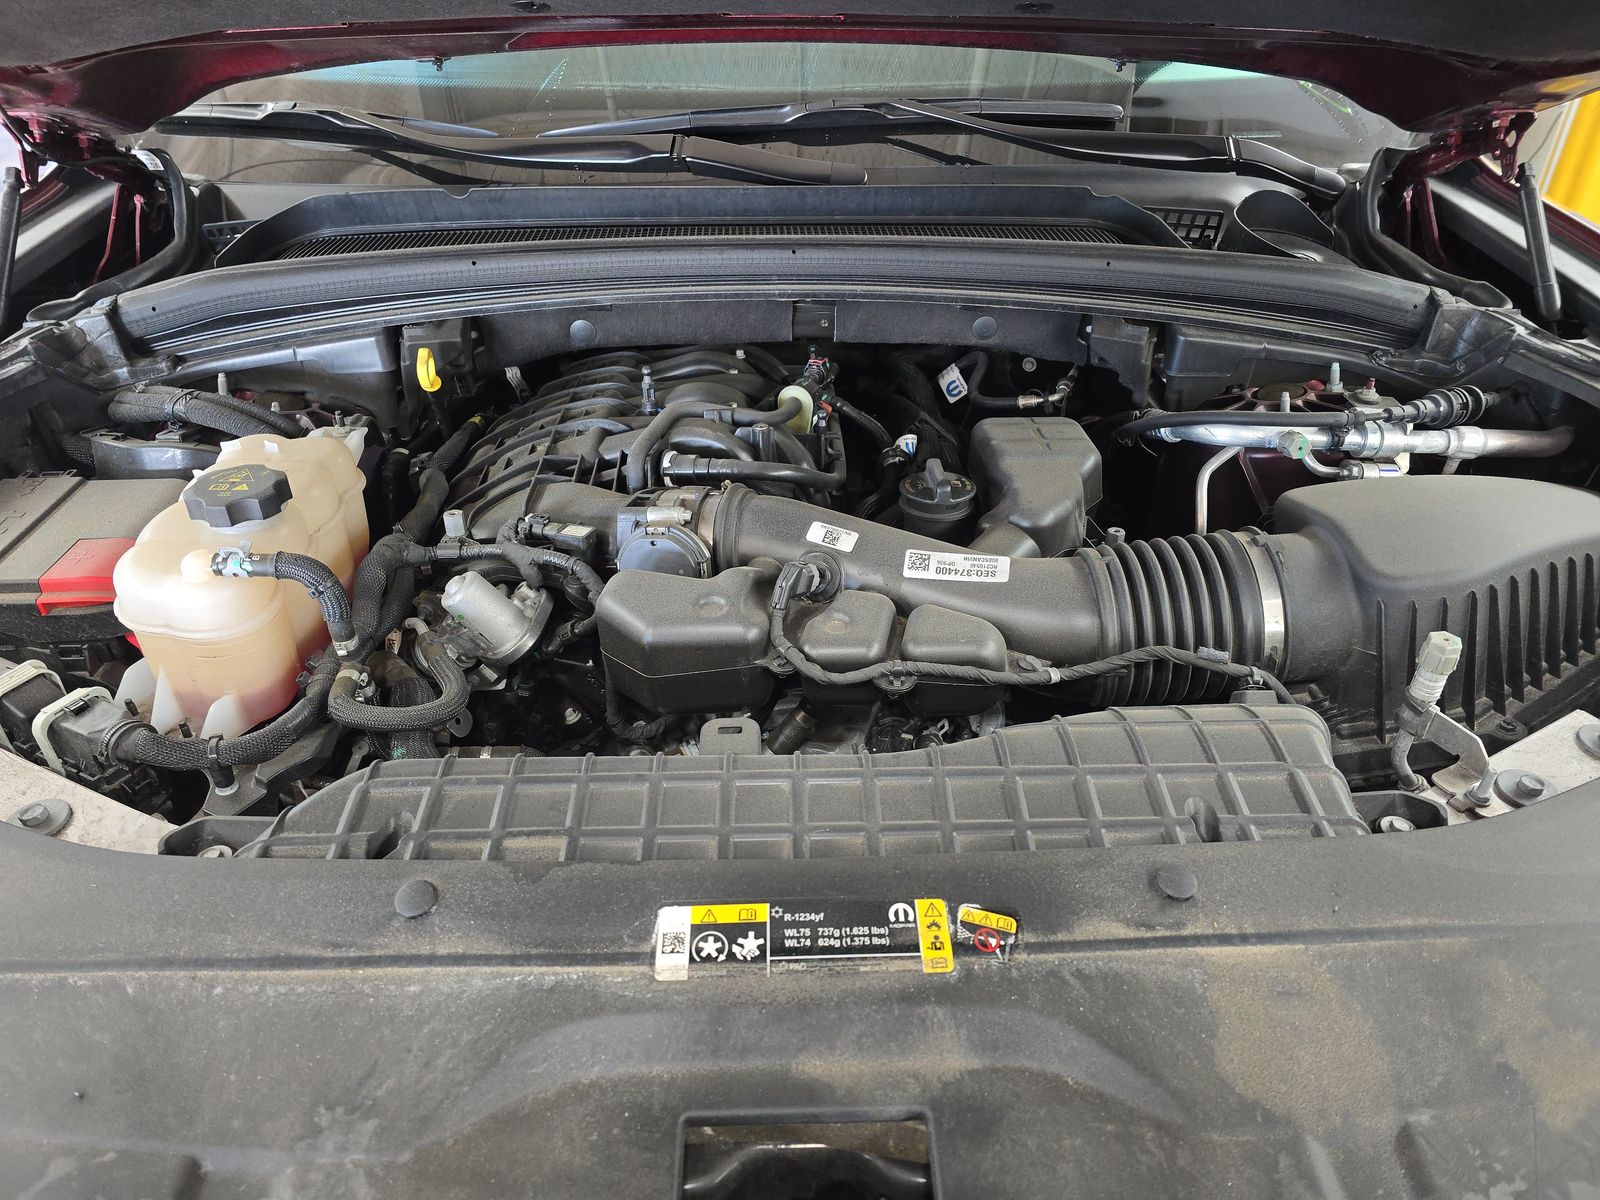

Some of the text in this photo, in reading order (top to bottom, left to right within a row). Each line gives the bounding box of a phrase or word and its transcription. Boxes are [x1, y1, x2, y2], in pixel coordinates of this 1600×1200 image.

[935, 566, 997, 578] SEQ:374400
[783, 912, 825, 923] R-1234yf
[783, 926, 889, 938] WL75 737g (1.625 lbs)
[784, 936, 890, 948] WL74 624g (1.375 lbs)
